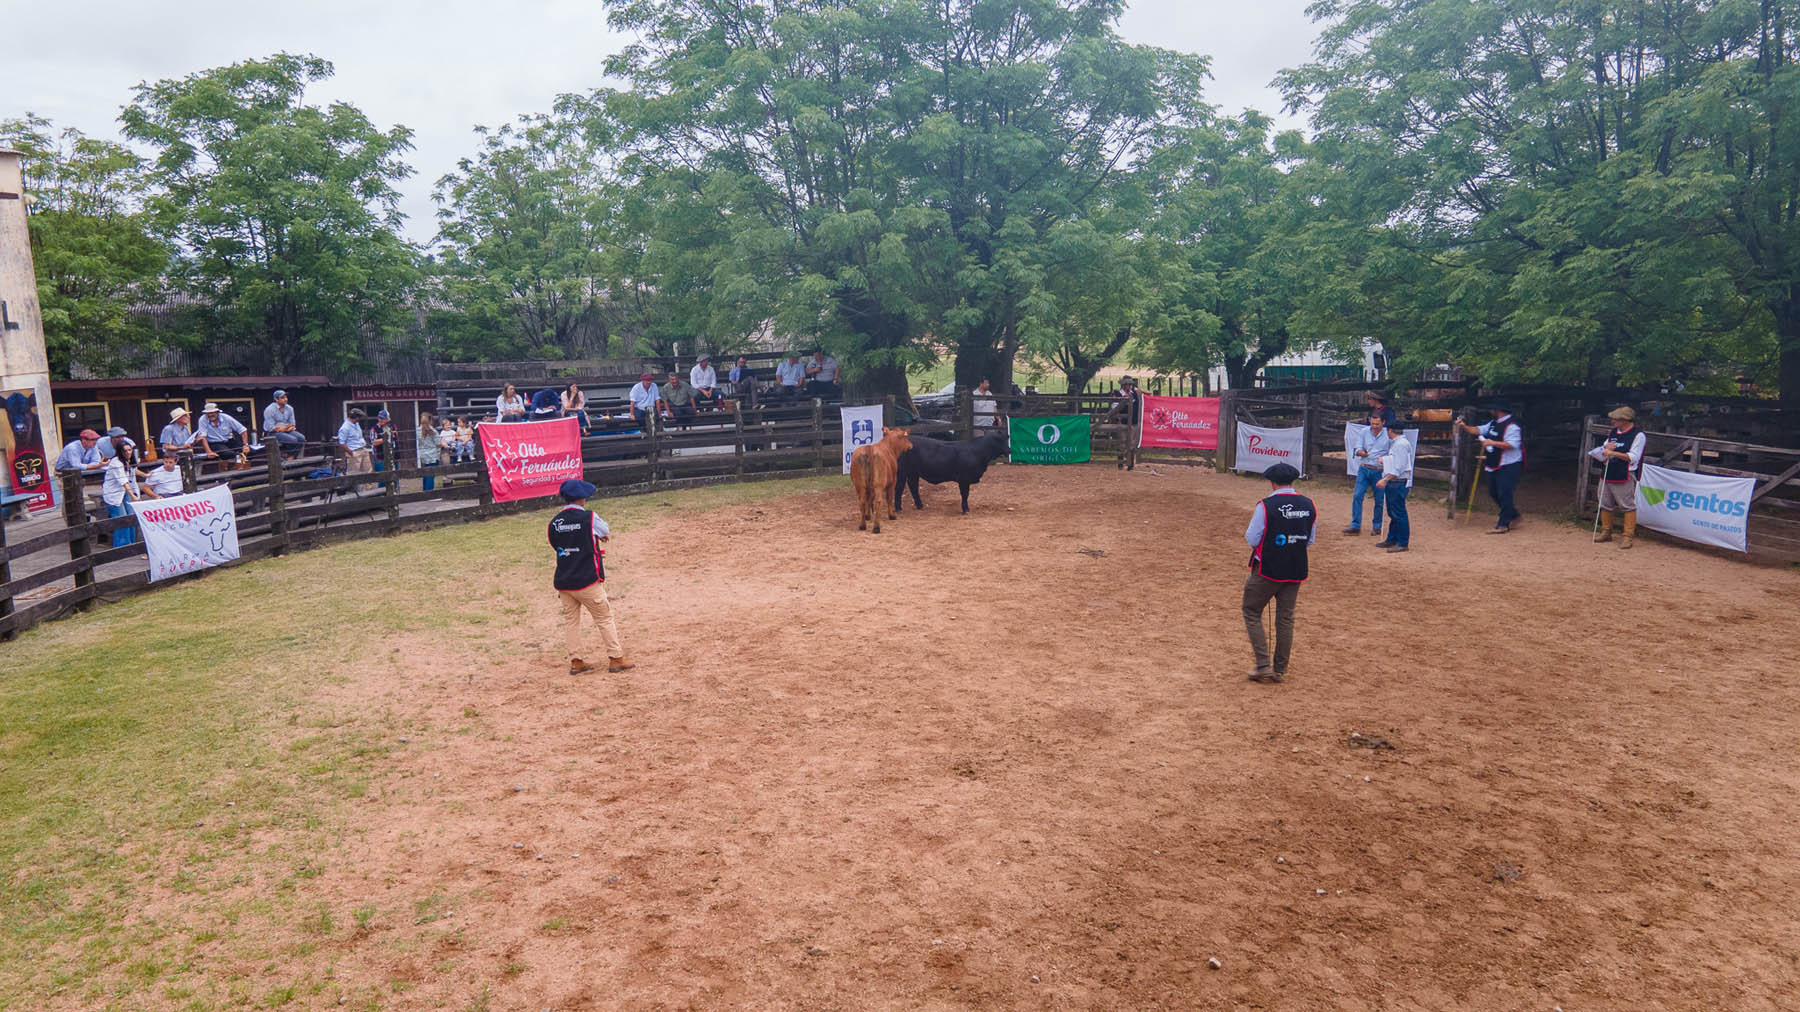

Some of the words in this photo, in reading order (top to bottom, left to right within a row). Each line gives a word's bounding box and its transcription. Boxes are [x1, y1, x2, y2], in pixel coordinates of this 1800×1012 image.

[1172, 410, 1189, 420] Otto
[519, 443, 545, 457] Otto
[1248, 434, 1289, 457] Providean
[521, 455, 580, 474] Fernández
[1666, 491, 1746, 516] gentos
